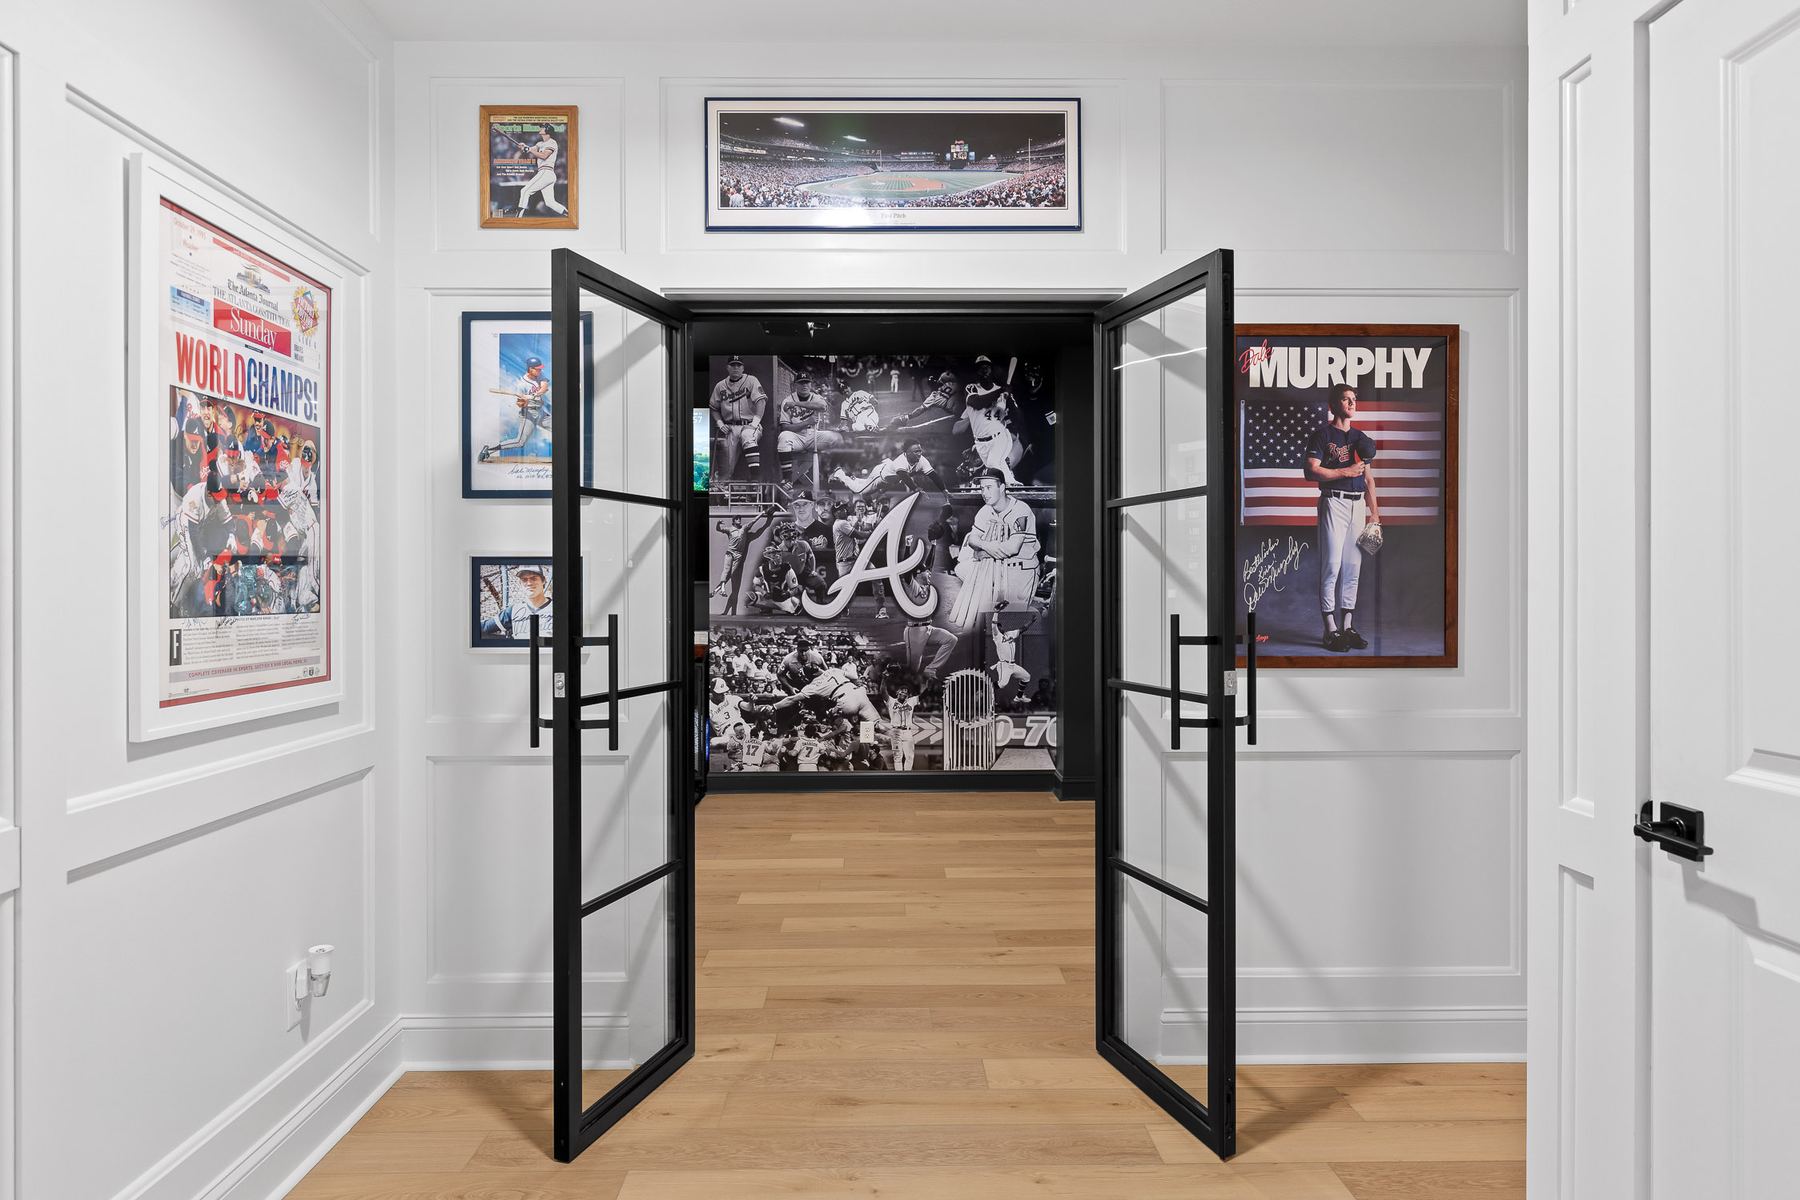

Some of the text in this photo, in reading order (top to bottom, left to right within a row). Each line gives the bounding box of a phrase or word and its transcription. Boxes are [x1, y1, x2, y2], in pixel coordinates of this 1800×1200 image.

[212, 286, 226, 300] THE
[230, 306, 278, 350] Sunday
[1238, 338, 1275, 374] Dale
[1249, 346, 1433, 389] MURPHY
[801, 491, 938, 620] A
[723, 711, 731, 720] 3
[746, 744, 760, 757] 17
[805, 746, 814, 757] 7
